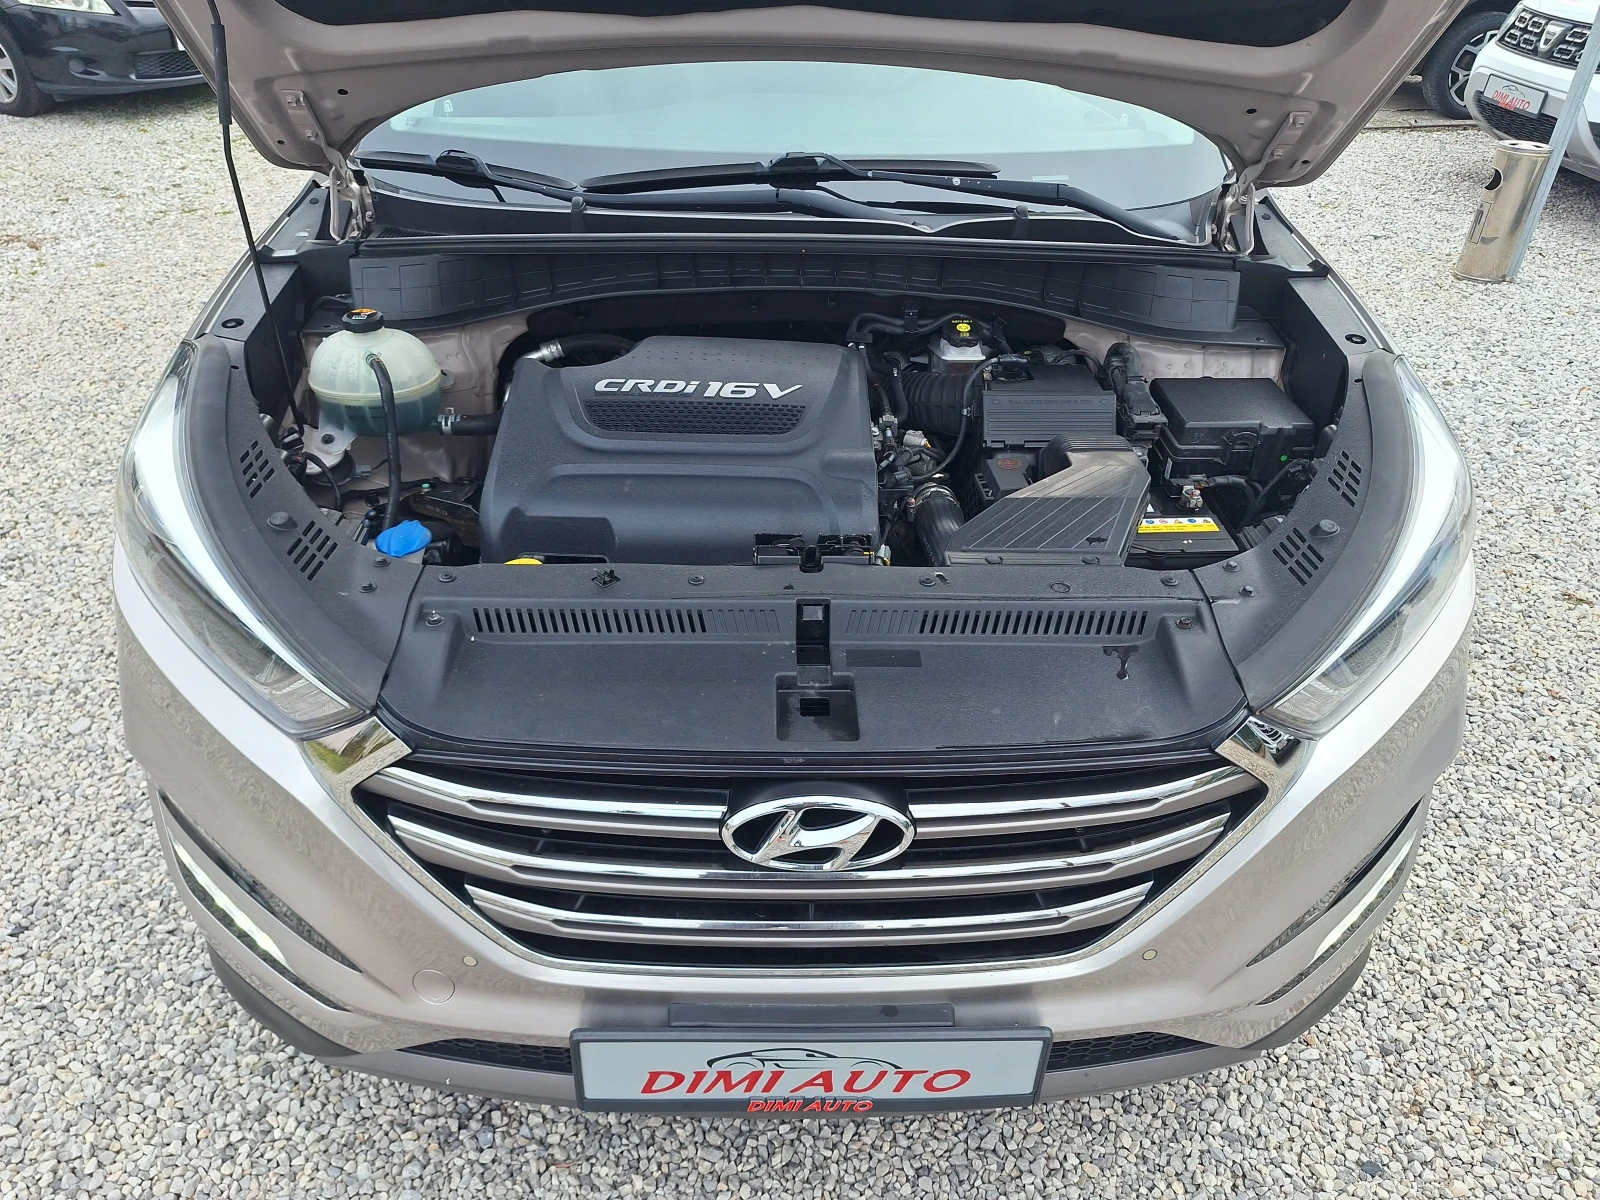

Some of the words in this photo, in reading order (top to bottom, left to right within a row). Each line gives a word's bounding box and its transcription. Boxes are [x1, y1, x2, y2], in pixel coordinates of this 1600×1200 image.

[1492, 90, 1510, 102] DIMI
[1508, 96, 1530, 110] AUTO
[594, 378, 700, 394] CRDi
[703, 380, 804, 399] 16V
[640, 1069, 780, 1094] DIMI
[789, 1069, 971, 1094] AUTO
[747, 1097, 804, 1112] DIMI
[803, 1097, 873, 1112] AUTO
